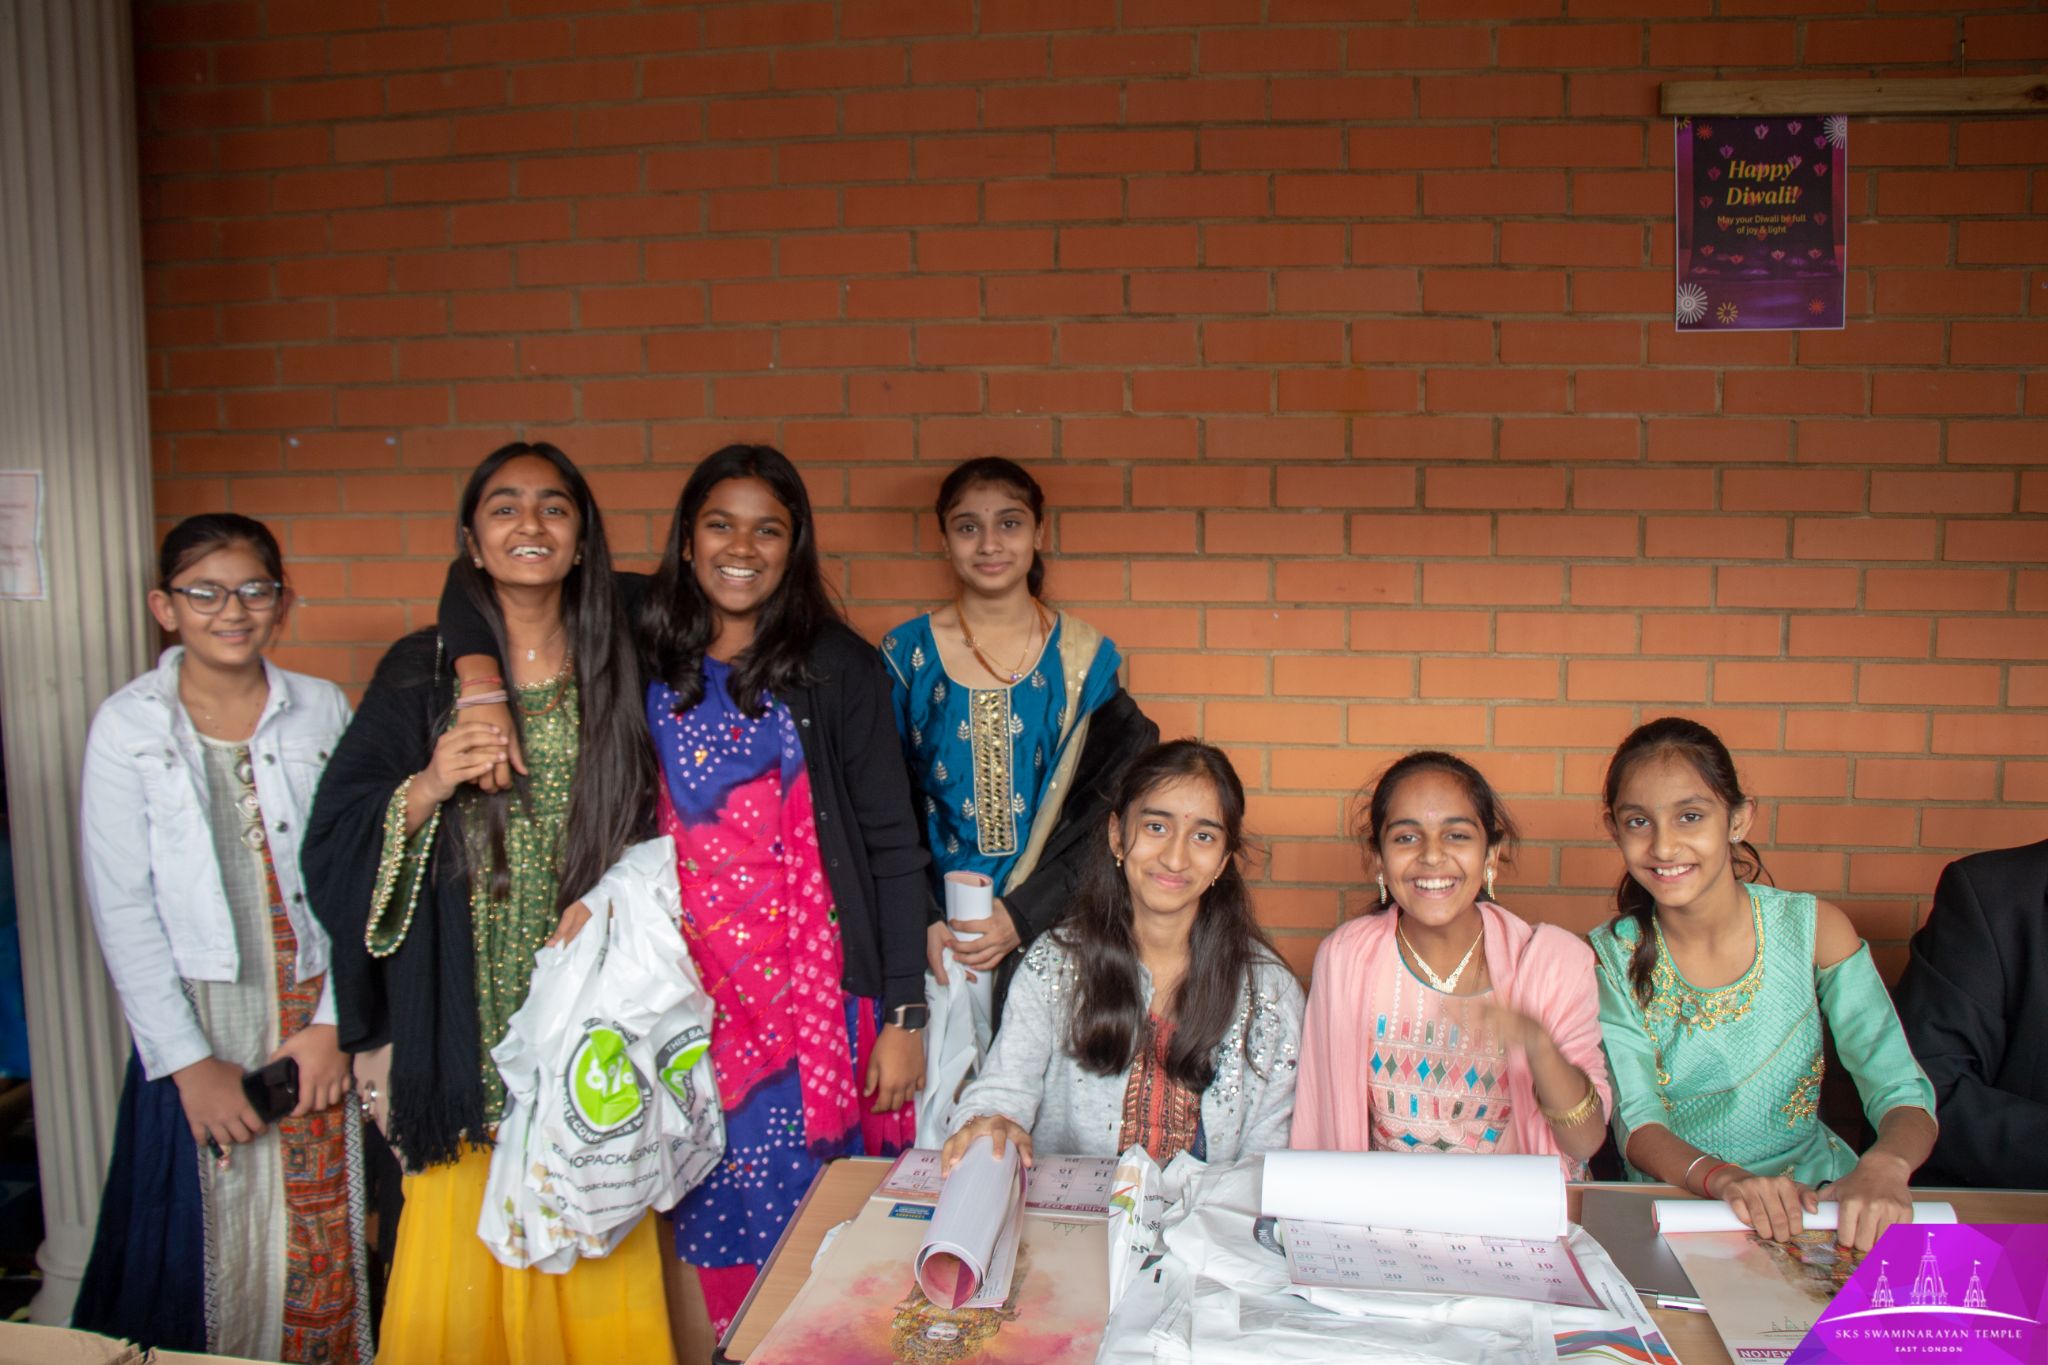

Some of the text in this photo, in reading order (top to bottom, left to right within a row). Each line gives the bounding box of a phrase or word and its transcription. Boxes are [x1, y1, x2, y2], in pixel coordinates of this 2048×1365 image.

[1729, 159, 1795, 182] Happy
[1726, 186, 1799, 206] Diwali!
[1717, 213, 1806, 225] May your Diwali be full
[1736, 225, 1786, 236] of joy & light
[665, 1027, 705, 1054] THIS BA
[1451, 1244, 1467, 1252] 10
[1530, 1247, 1547, 1255] 12
[1300, 1267, 1318, 1275] 27
[1740, 1350, 1796, 1359] NOVEM
